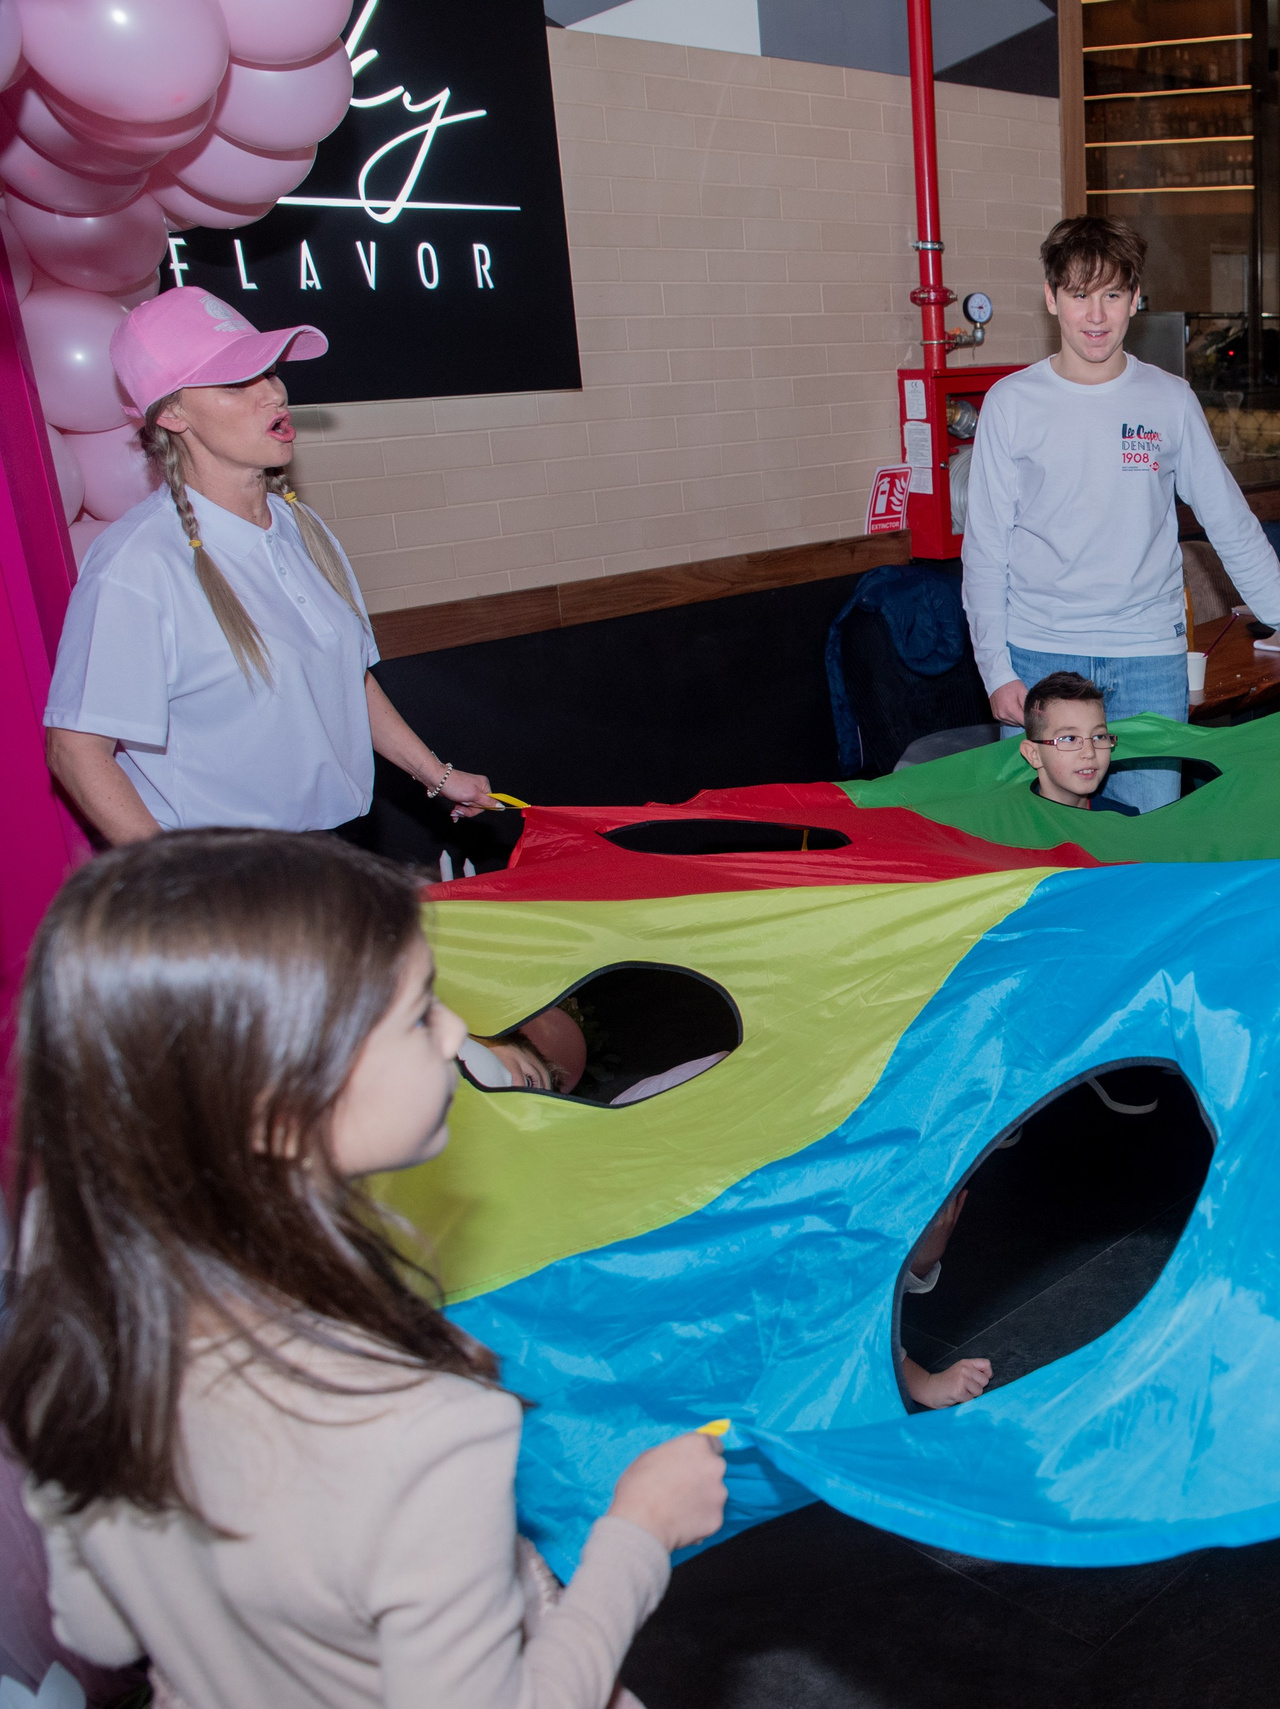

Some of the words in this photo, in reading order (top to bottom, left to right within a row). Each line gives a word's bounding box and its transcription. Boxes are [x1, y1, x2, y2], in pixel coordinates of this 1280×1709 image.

[168, 237, 495, 290] FLAVOR
[1122, 423, 1135, 439] Lee
[1137, 424, 1162, 443] Cooper
[1122, 441, 1160, 452] DENIM
[1122, 453, 1150, 463] 1908
[871, 521, 900, 530] EXTINCTOR
